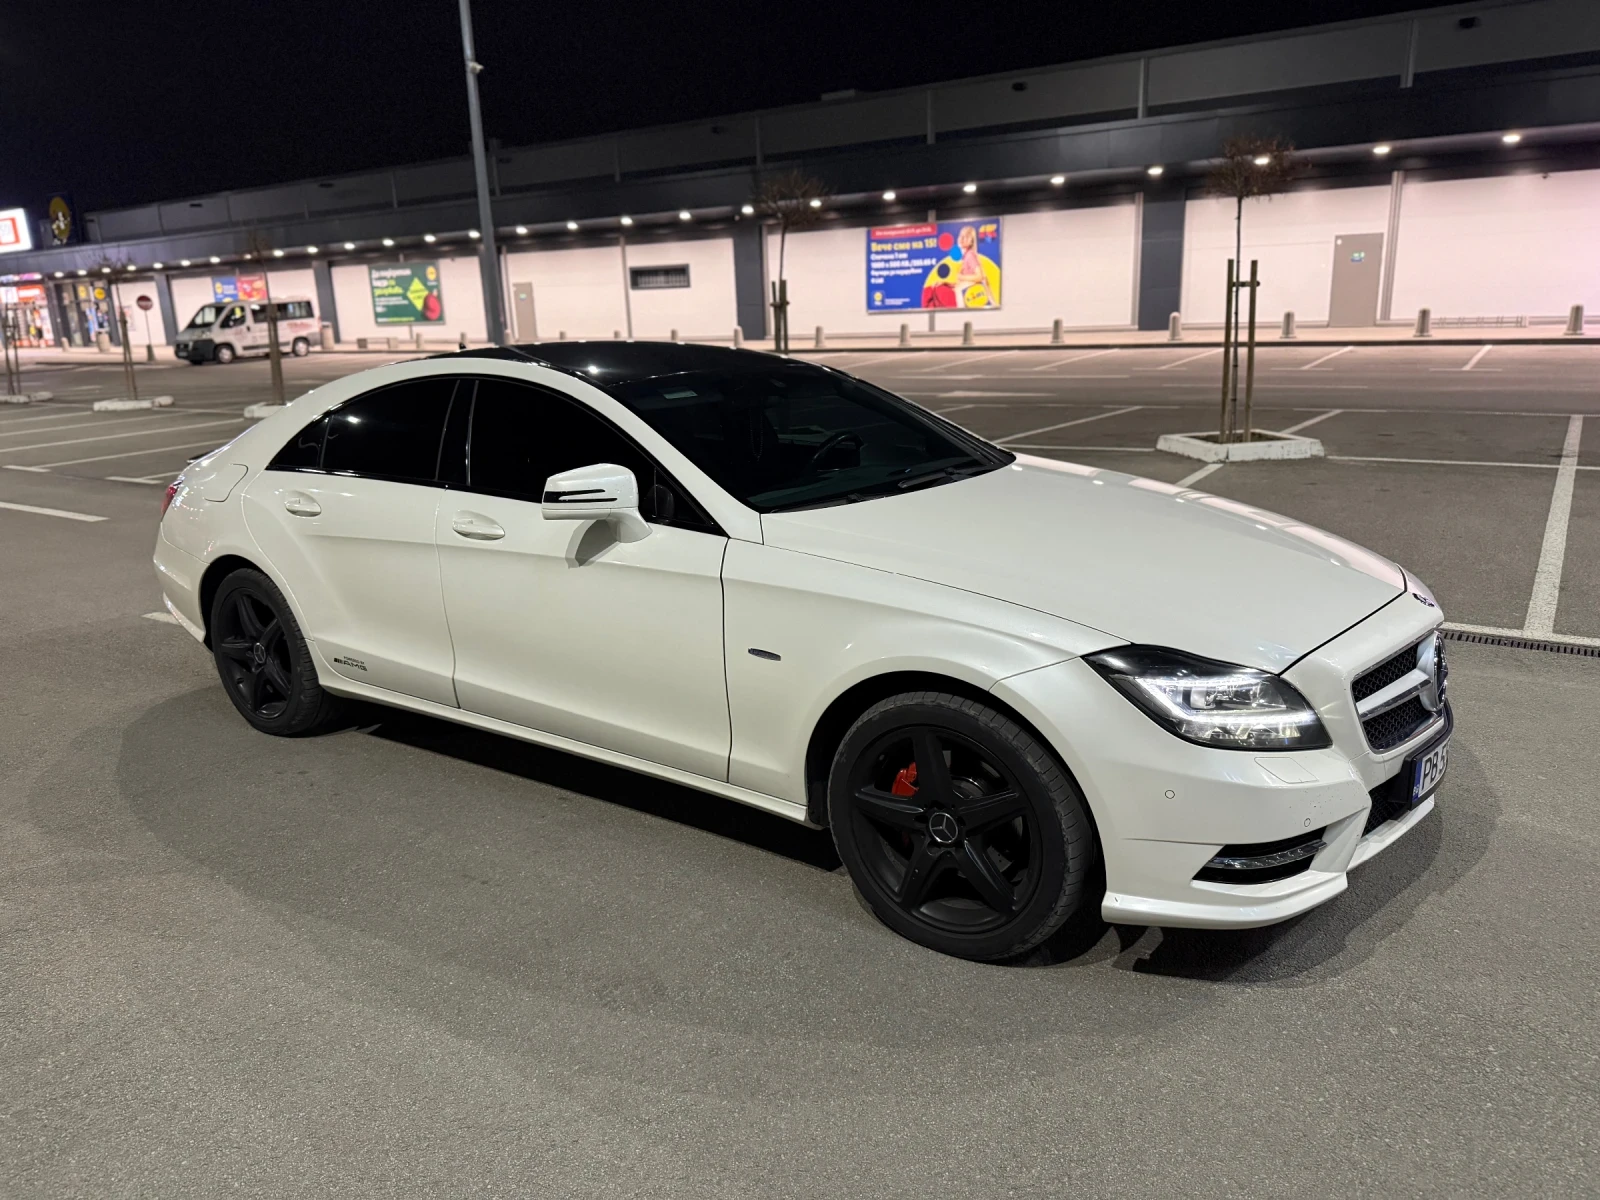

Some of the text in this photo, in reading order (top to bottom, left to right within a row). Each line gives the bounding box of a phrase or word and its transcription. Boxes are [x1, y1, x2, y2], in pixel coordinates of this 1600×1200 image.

[871, 238, 937, 252] Вече сме на 15!
[344, 660, 368, 672] AMG
[1421, 751, 1439, 790] PB
